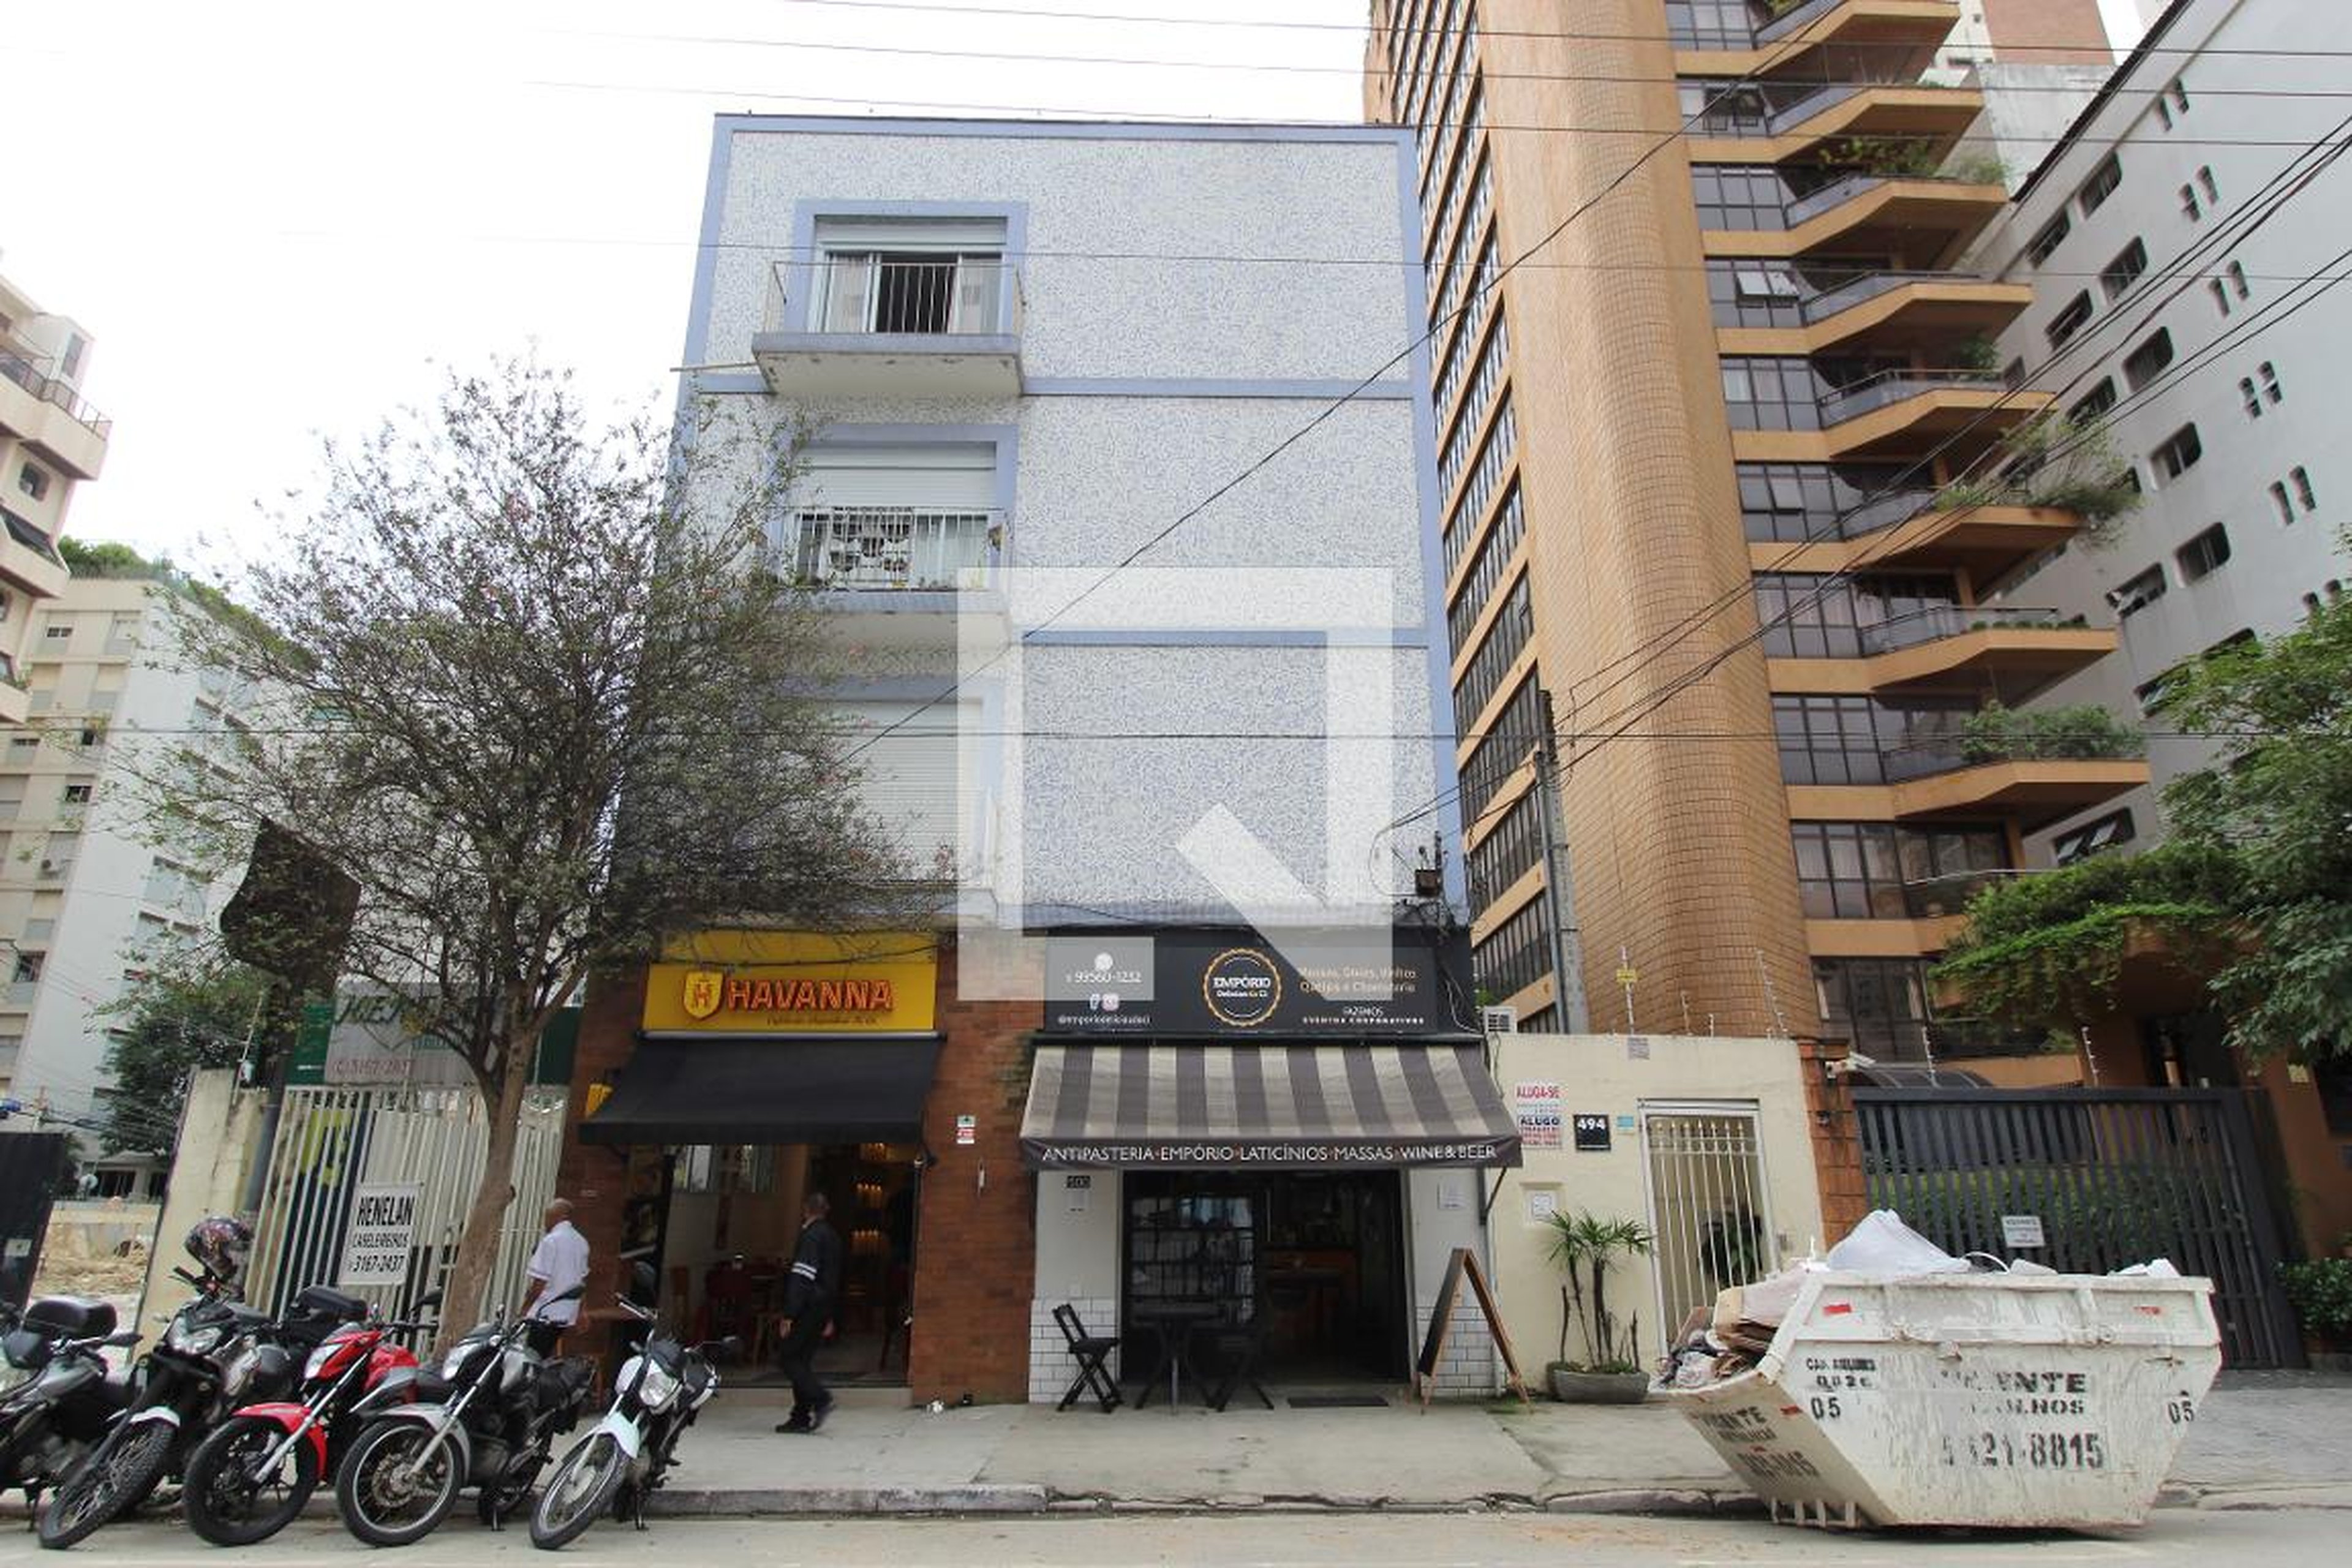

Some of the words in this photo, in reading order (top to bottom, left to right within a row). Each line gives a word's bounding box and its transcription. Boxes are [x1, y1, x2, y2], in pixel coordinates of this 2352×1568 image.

[727, 979, 894, 1011] HAVANNA
[1577, 1117, 1607, 1130] 494
[1042, 1147, 1155, 1161] ANTIPASTERIA
[1160, 1143, 1234, 1161] EMPÓRIO
[1239, 1143, 1329, 1161] LATICÍNIOS
[1333, 1147, 1394, 1160] MASSAS
[1811, 1396, 1841, 1420] 05
[2168, 1400, 2194, 1424] 05
